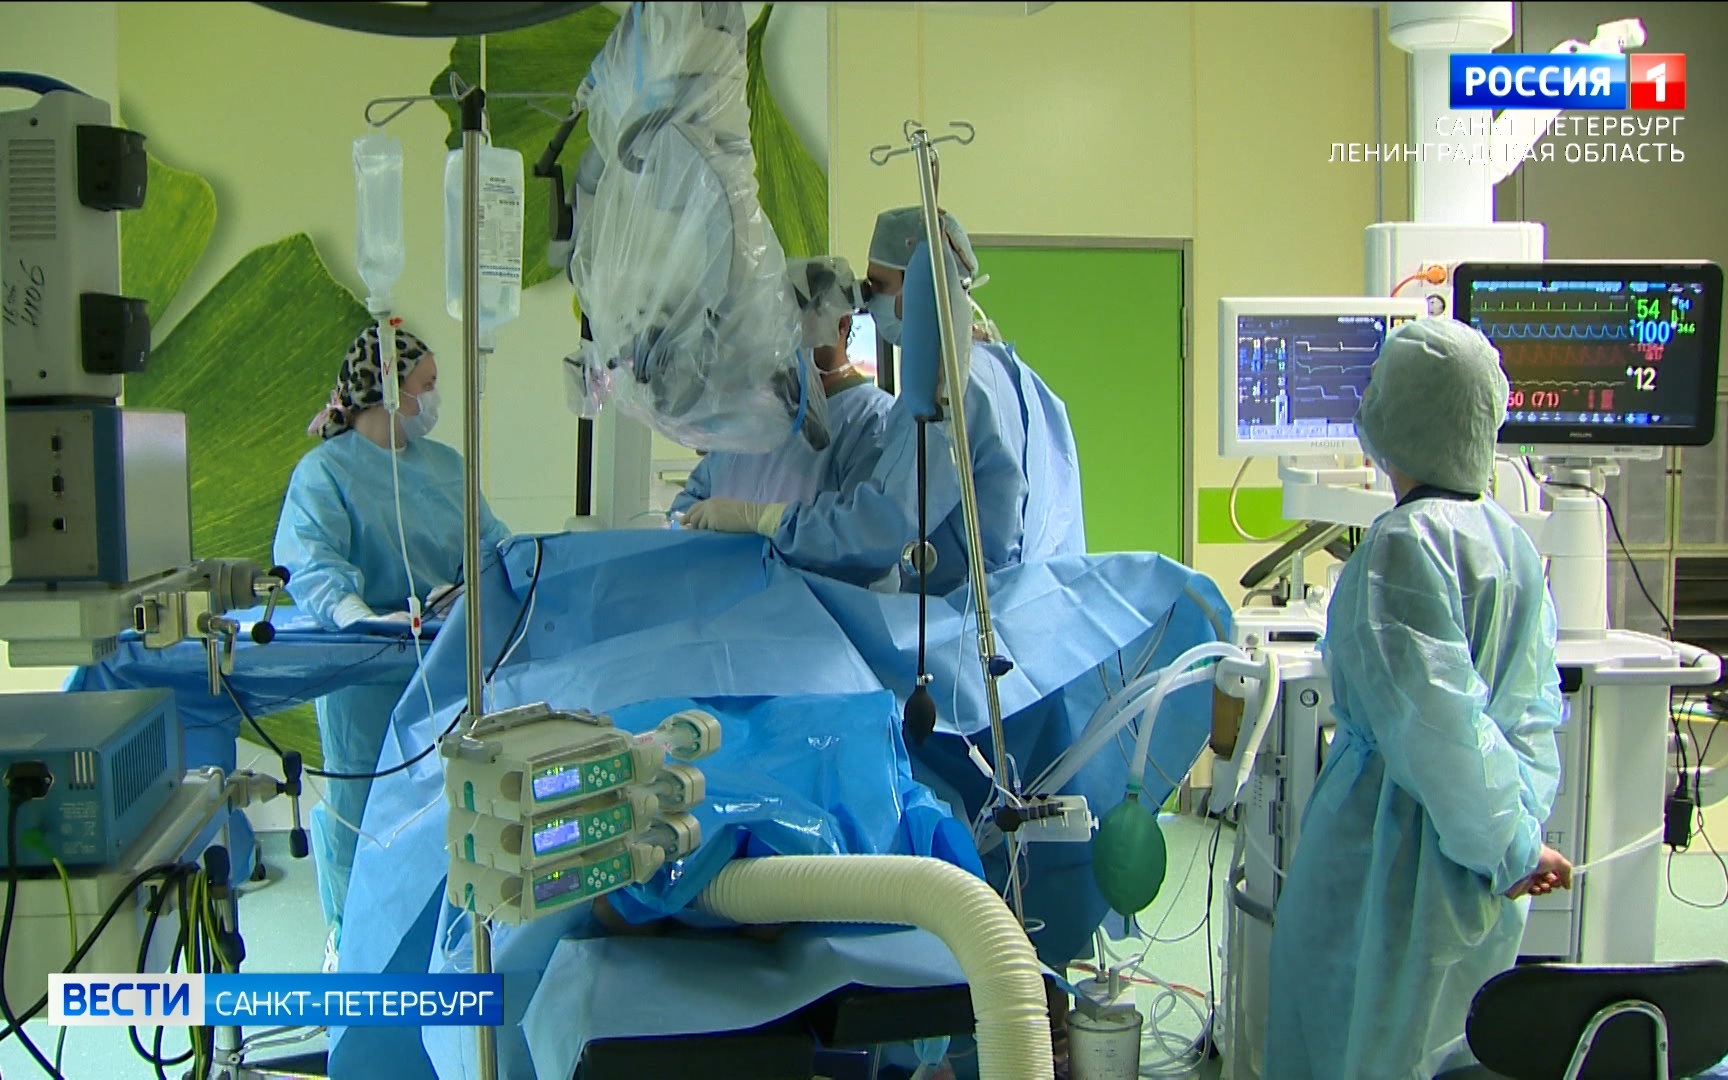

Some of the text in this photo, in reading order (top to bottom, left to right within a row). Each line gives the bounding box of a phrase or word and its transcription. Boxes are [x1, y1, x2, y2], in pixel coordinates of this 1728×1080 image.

[1636, 298, 1660, 320] 54
[1636, 320, 1670, 343] 100
[1634, 367, 1657, 390] 12
[1531, 391, 1560, 408] (71)
